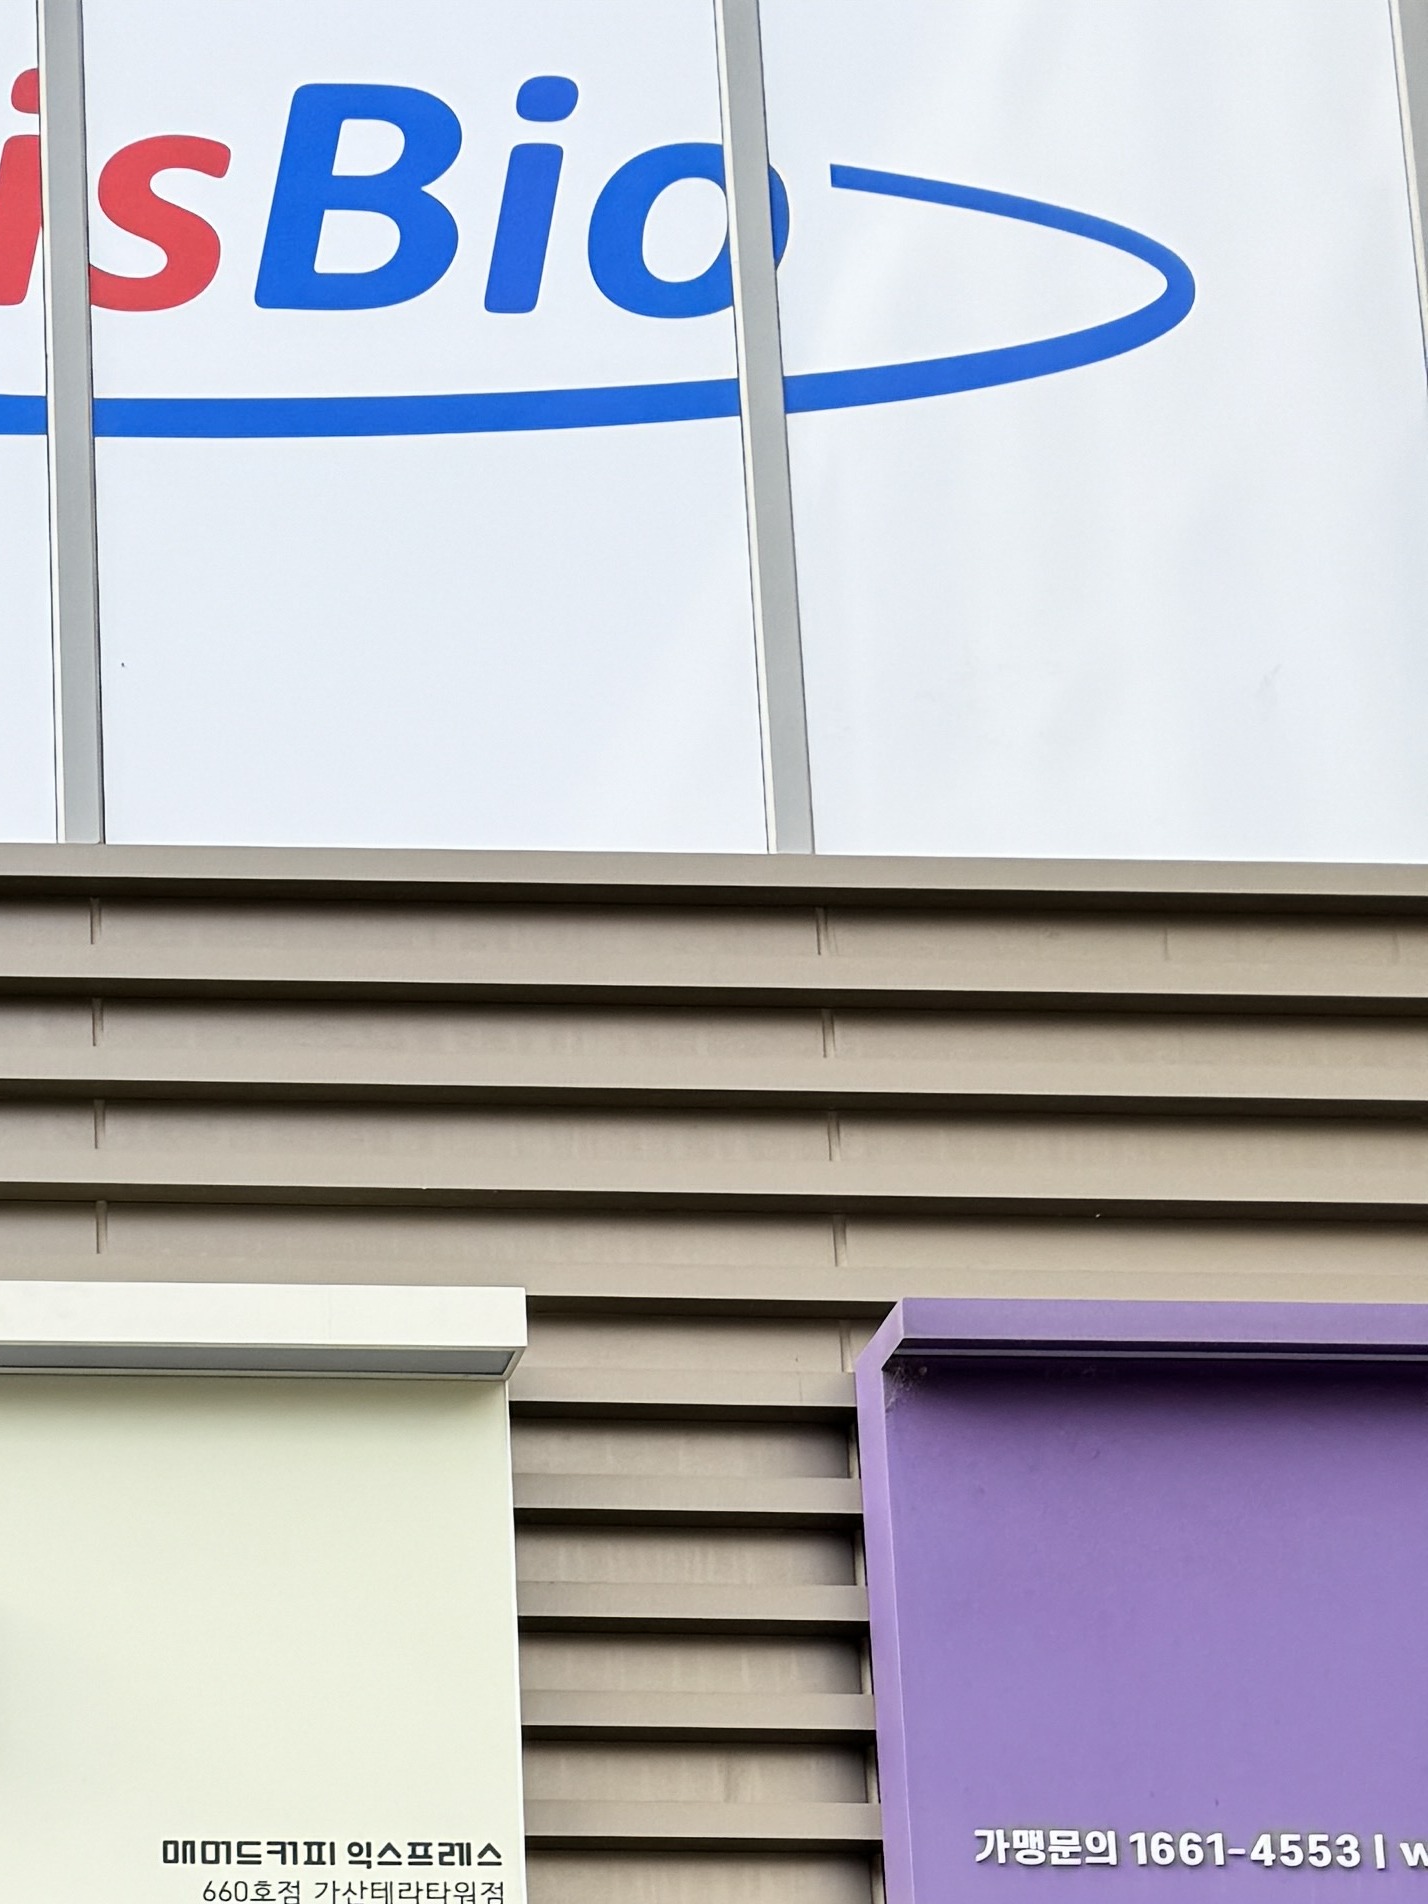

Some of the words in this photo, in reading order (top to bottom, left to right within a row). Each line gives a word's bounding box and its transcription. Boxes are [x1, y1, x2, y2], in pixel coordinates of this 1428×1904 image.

[163, 1840, 335, 1865] 매머드커피
[348, 1842, 502, 1869] 익스프레스
[974, 1828, 1118, 1865] 가맹문의
[1129, 1832, 1361, 1867] 1661-4553
